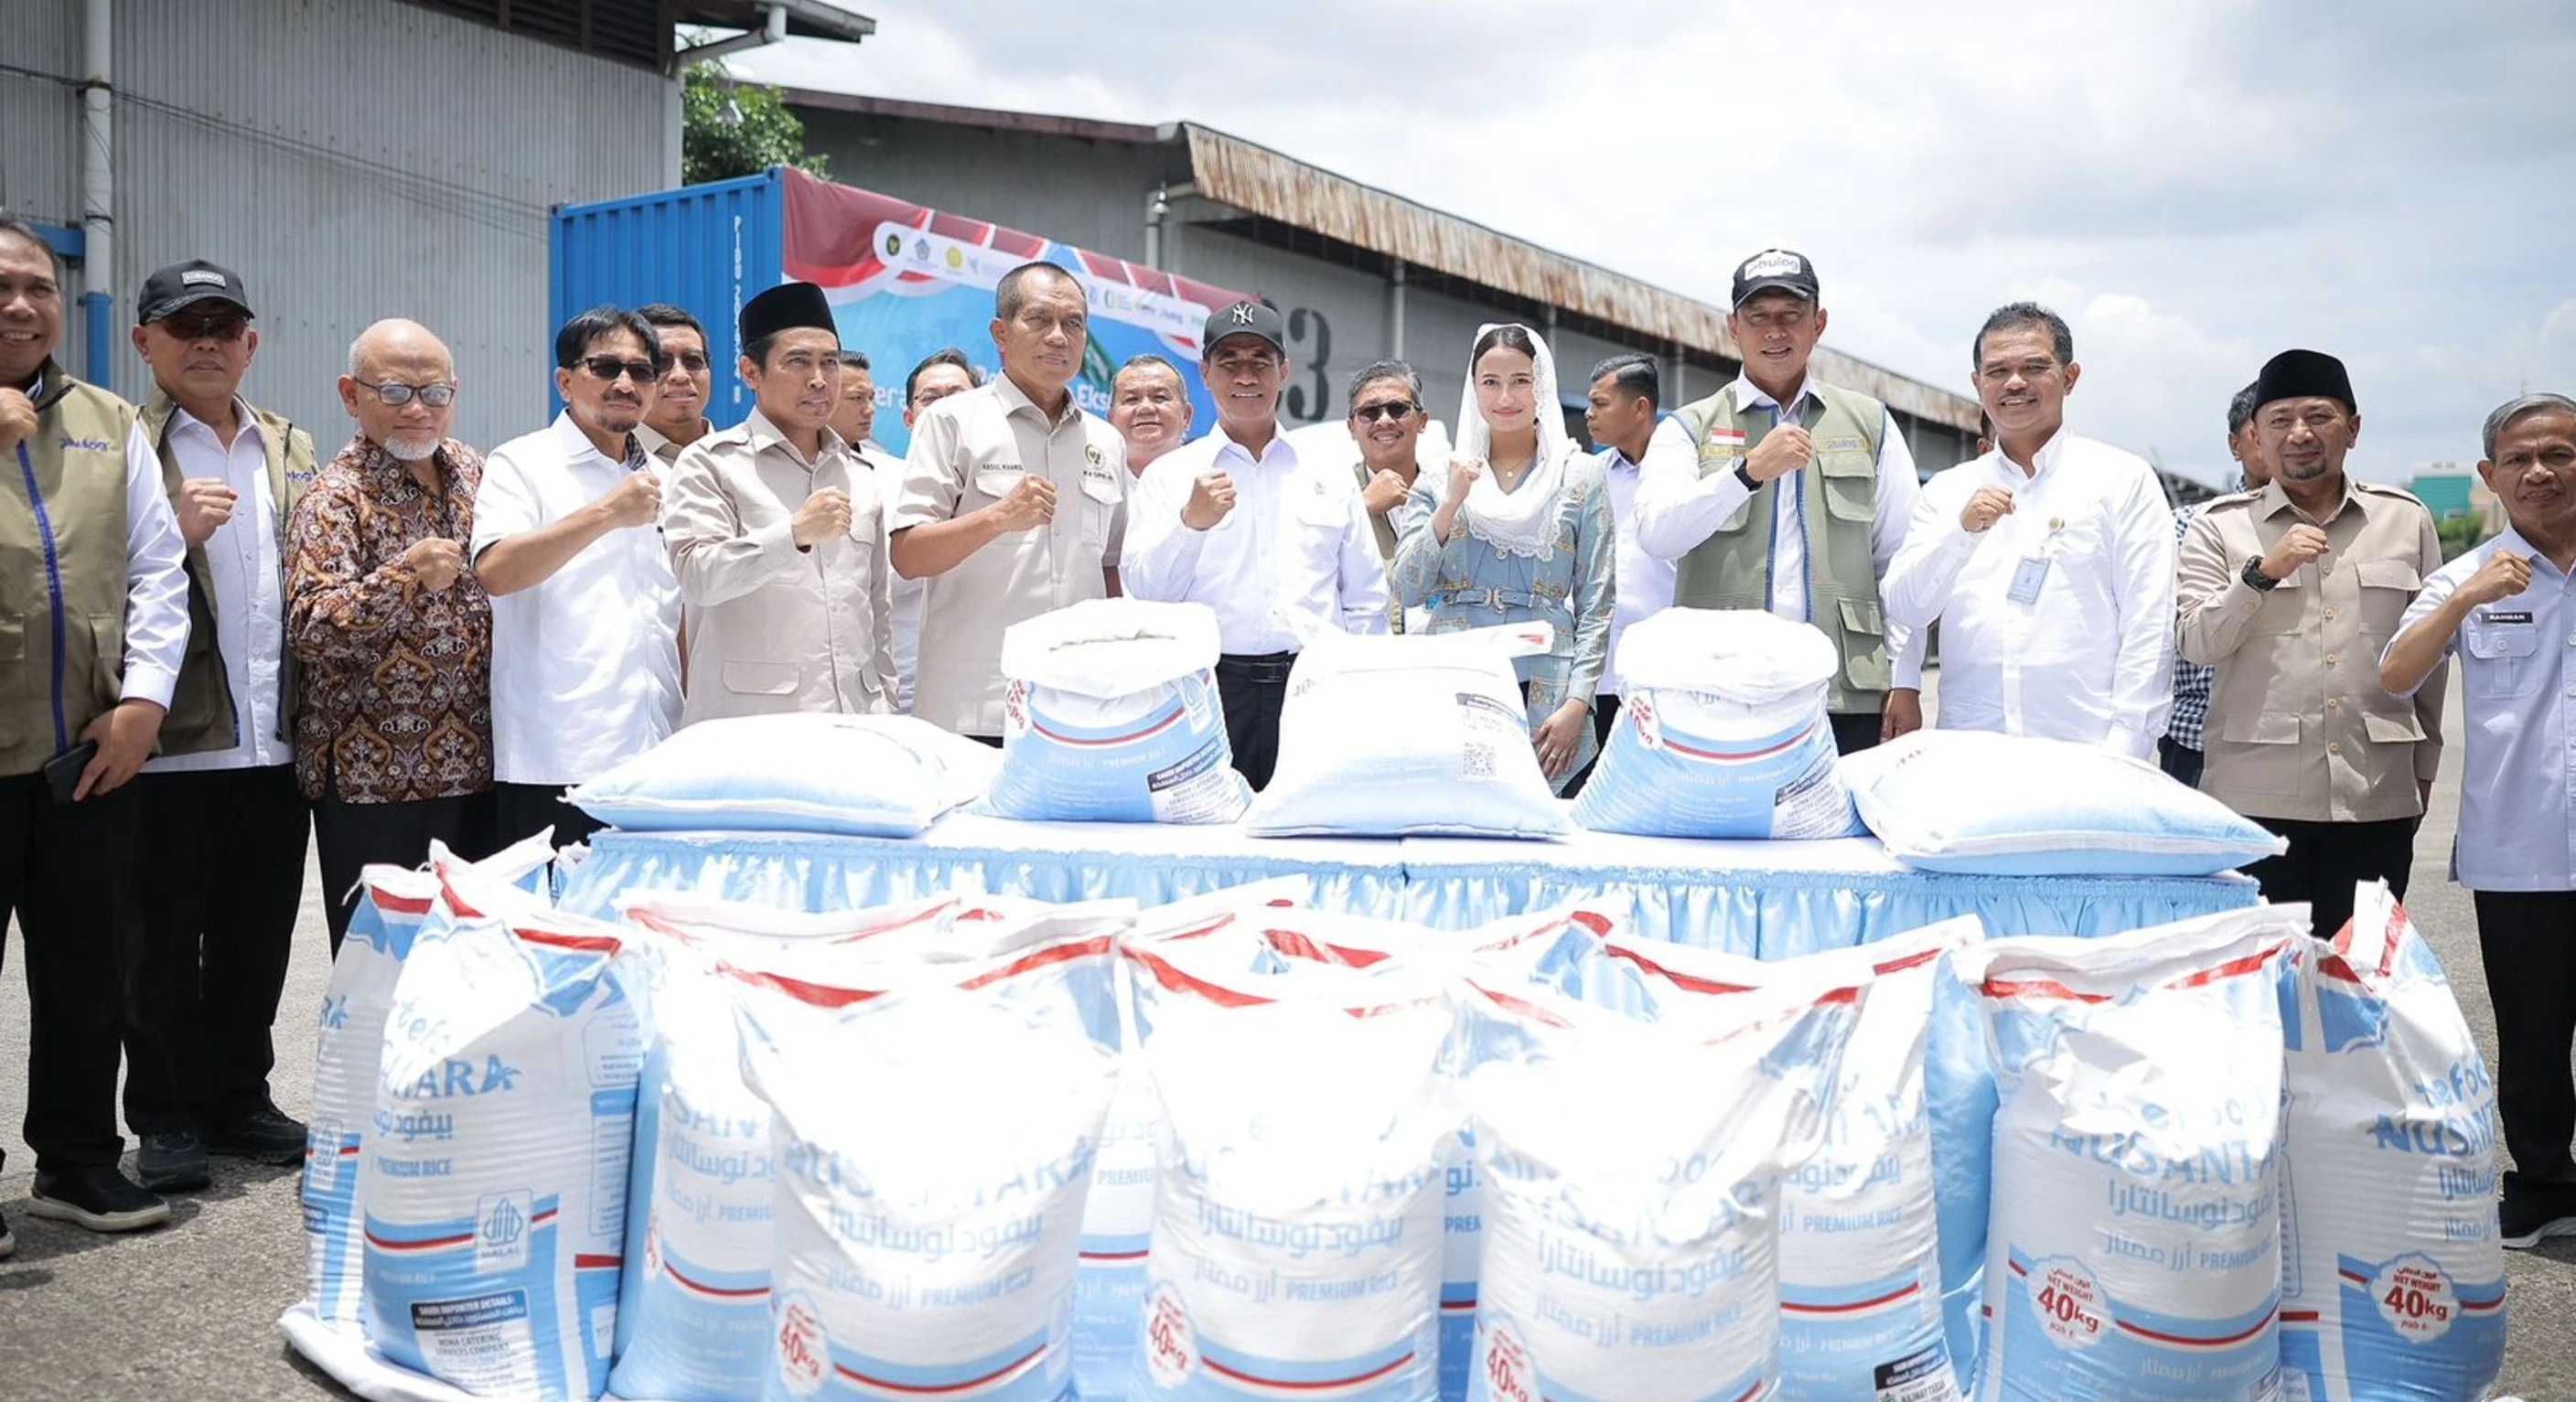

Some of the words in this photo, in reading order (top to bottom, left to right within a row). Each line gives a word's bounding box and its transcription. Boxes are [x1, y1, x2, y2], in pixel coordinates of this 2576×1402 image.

[1097, 1168, 1155, 1187] PREMIU
[718, 1201, 776, 1222] PREMIU
[1802, 1211, 1874, 1234] PREMIUM
[2393, 1273, 2410, 1285] NET
[2410, 1279, 2442, 1293] WEIGHT
[2037, 1284, 2098, 1333] 40kg
[2383, 1284, 2448, 1322] 40kg
